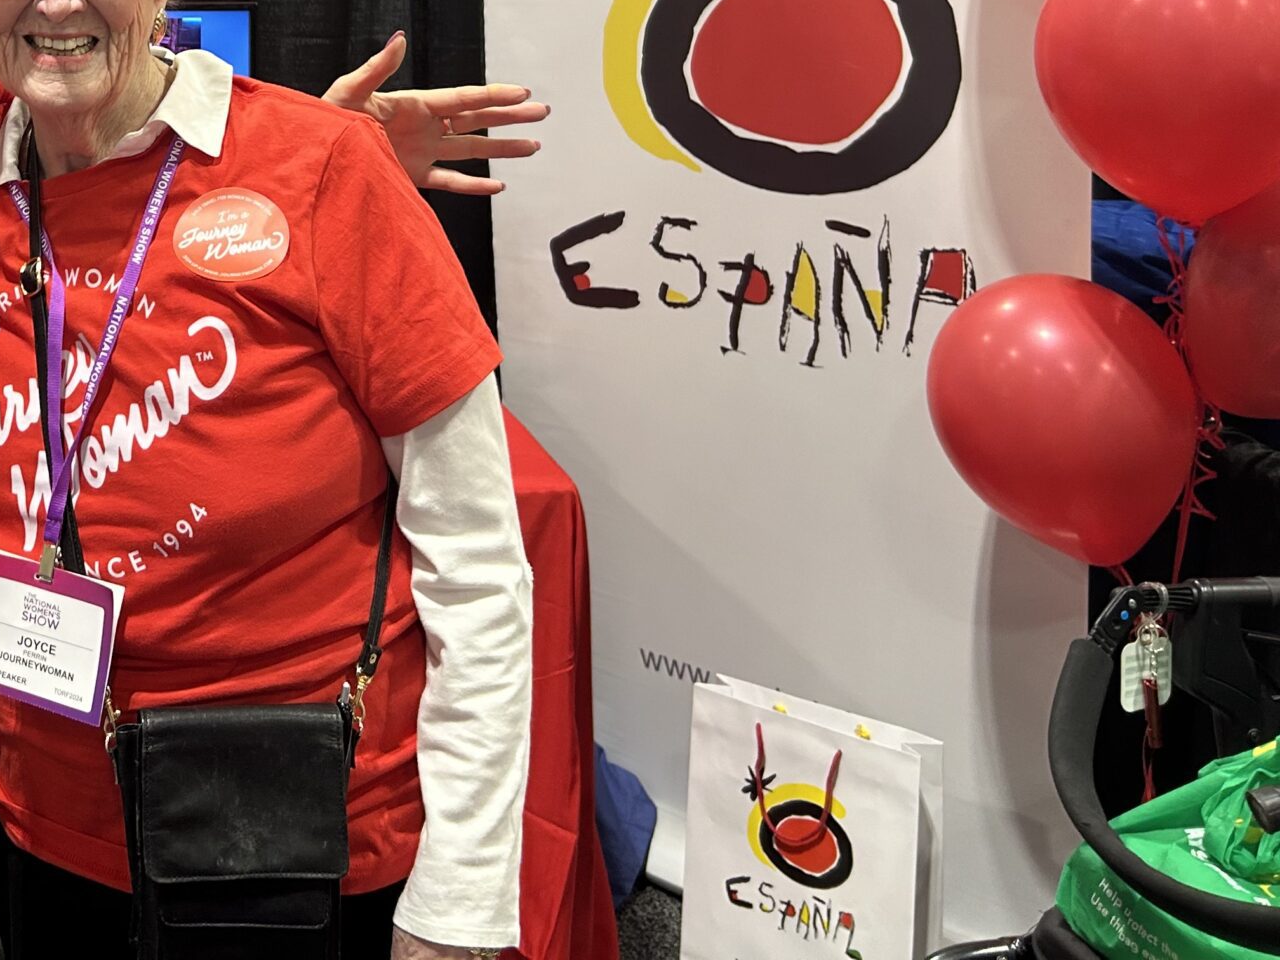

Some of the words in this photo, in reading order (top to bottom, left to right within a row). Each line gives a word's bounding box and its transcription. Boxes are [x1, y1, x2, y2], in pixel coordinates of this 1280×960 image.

[144, 170, 172, 226] WOMEN'S
[132, 227, 152, 265] SHOW
[178, 223, 247, 249] Journey
[204, 231, 284, 261] Woman
[65, 266, 155, 319] WOMN
[550, 210, 977, 368] ESPAÑA
[99, 295, 128, 359] NATIONAL
[84, 550, 146, 580] NCE
[153, 502, 207, 557] 1994
[23, 596, 61, 612] NATIONAL
[23, 603, 61, 620] WOMEN'S
[21, 611, 60, 630] SHOW
[17, 635, 57, 656] JOYCE
[22, 649, 47, 662] PERRIN
[1091, 892, 1109, 917] Use
[1099, 877, 1123, 908] Help
[726, 876, 857, 954] ESPAÑA
